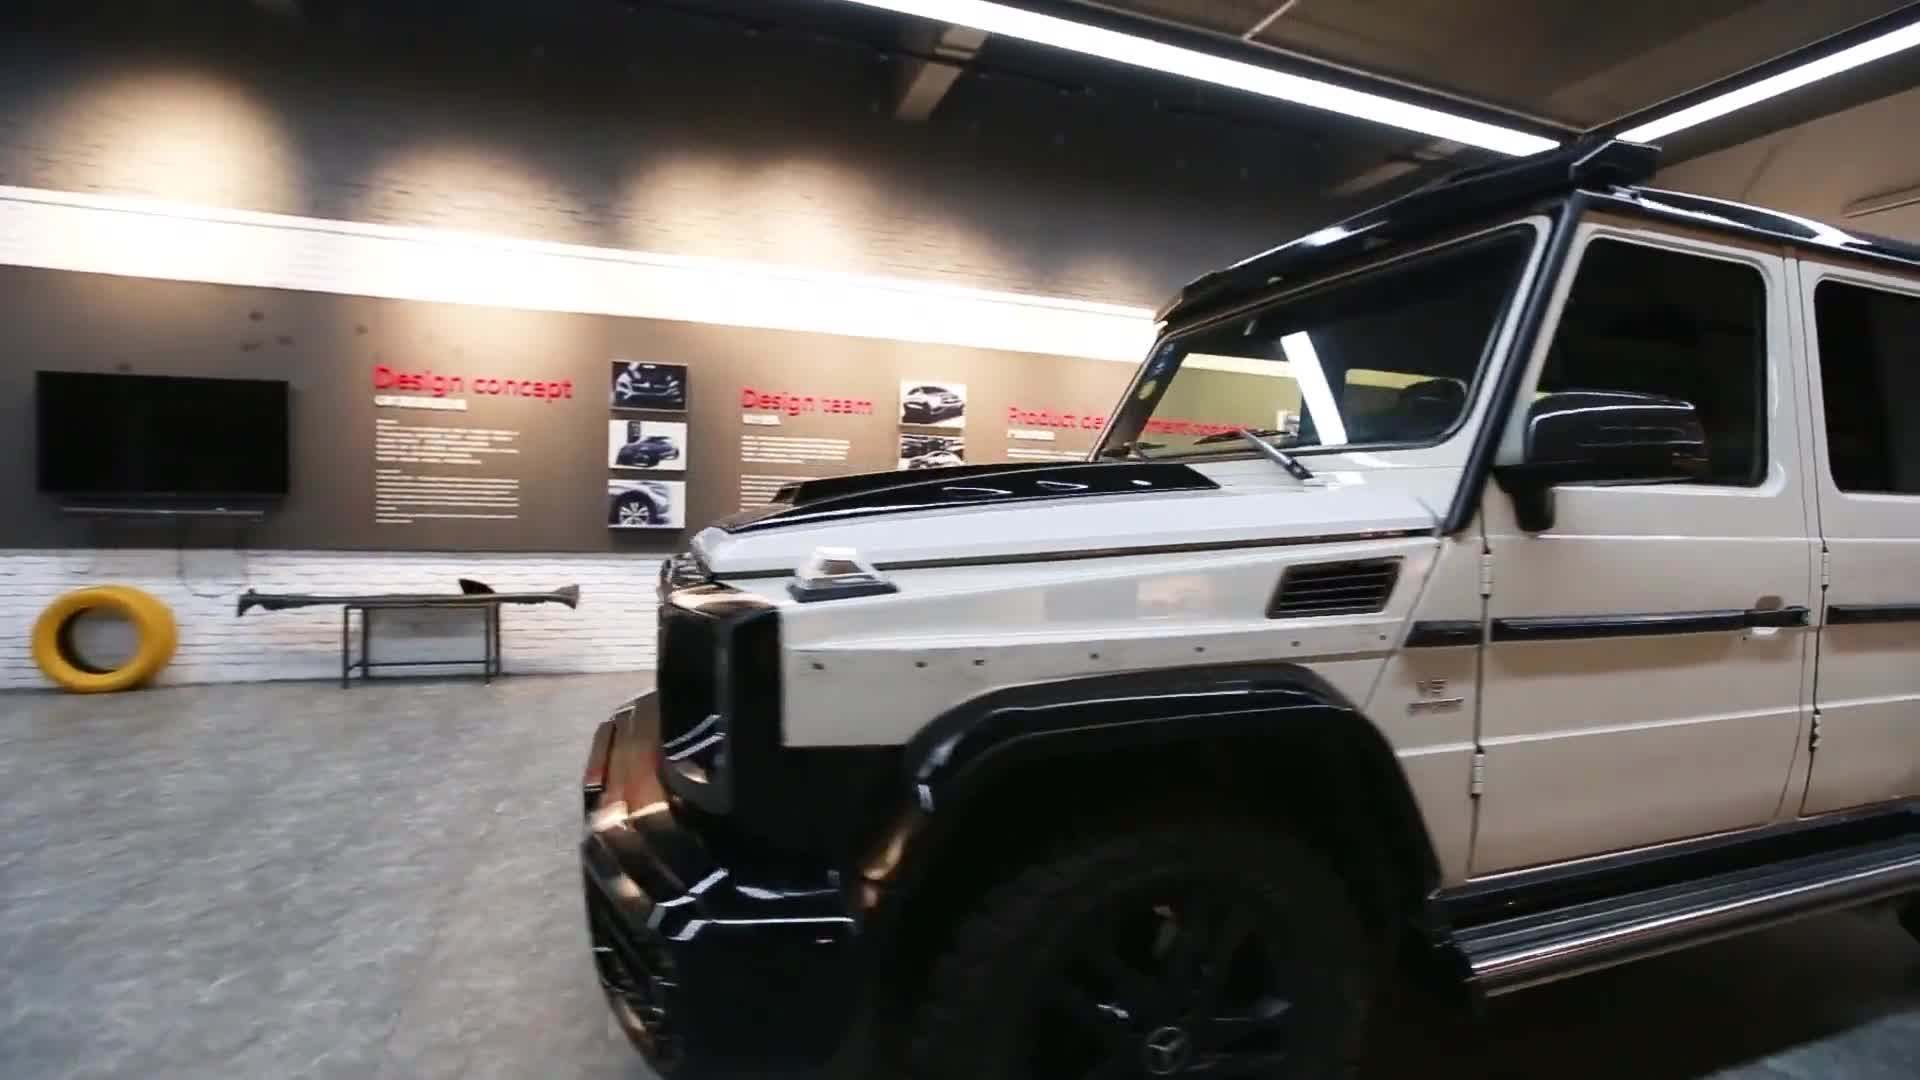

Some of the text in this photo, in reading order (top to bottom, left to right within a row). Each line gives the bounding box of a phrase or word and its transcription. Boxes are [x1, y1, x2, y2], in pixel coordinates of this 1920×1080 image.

[374, 365, 464, 397] Design
[474, 376, 573, 403] concept
[742, 388, 873, 416] Design team
[1007, 406, 1077, 429] Product
